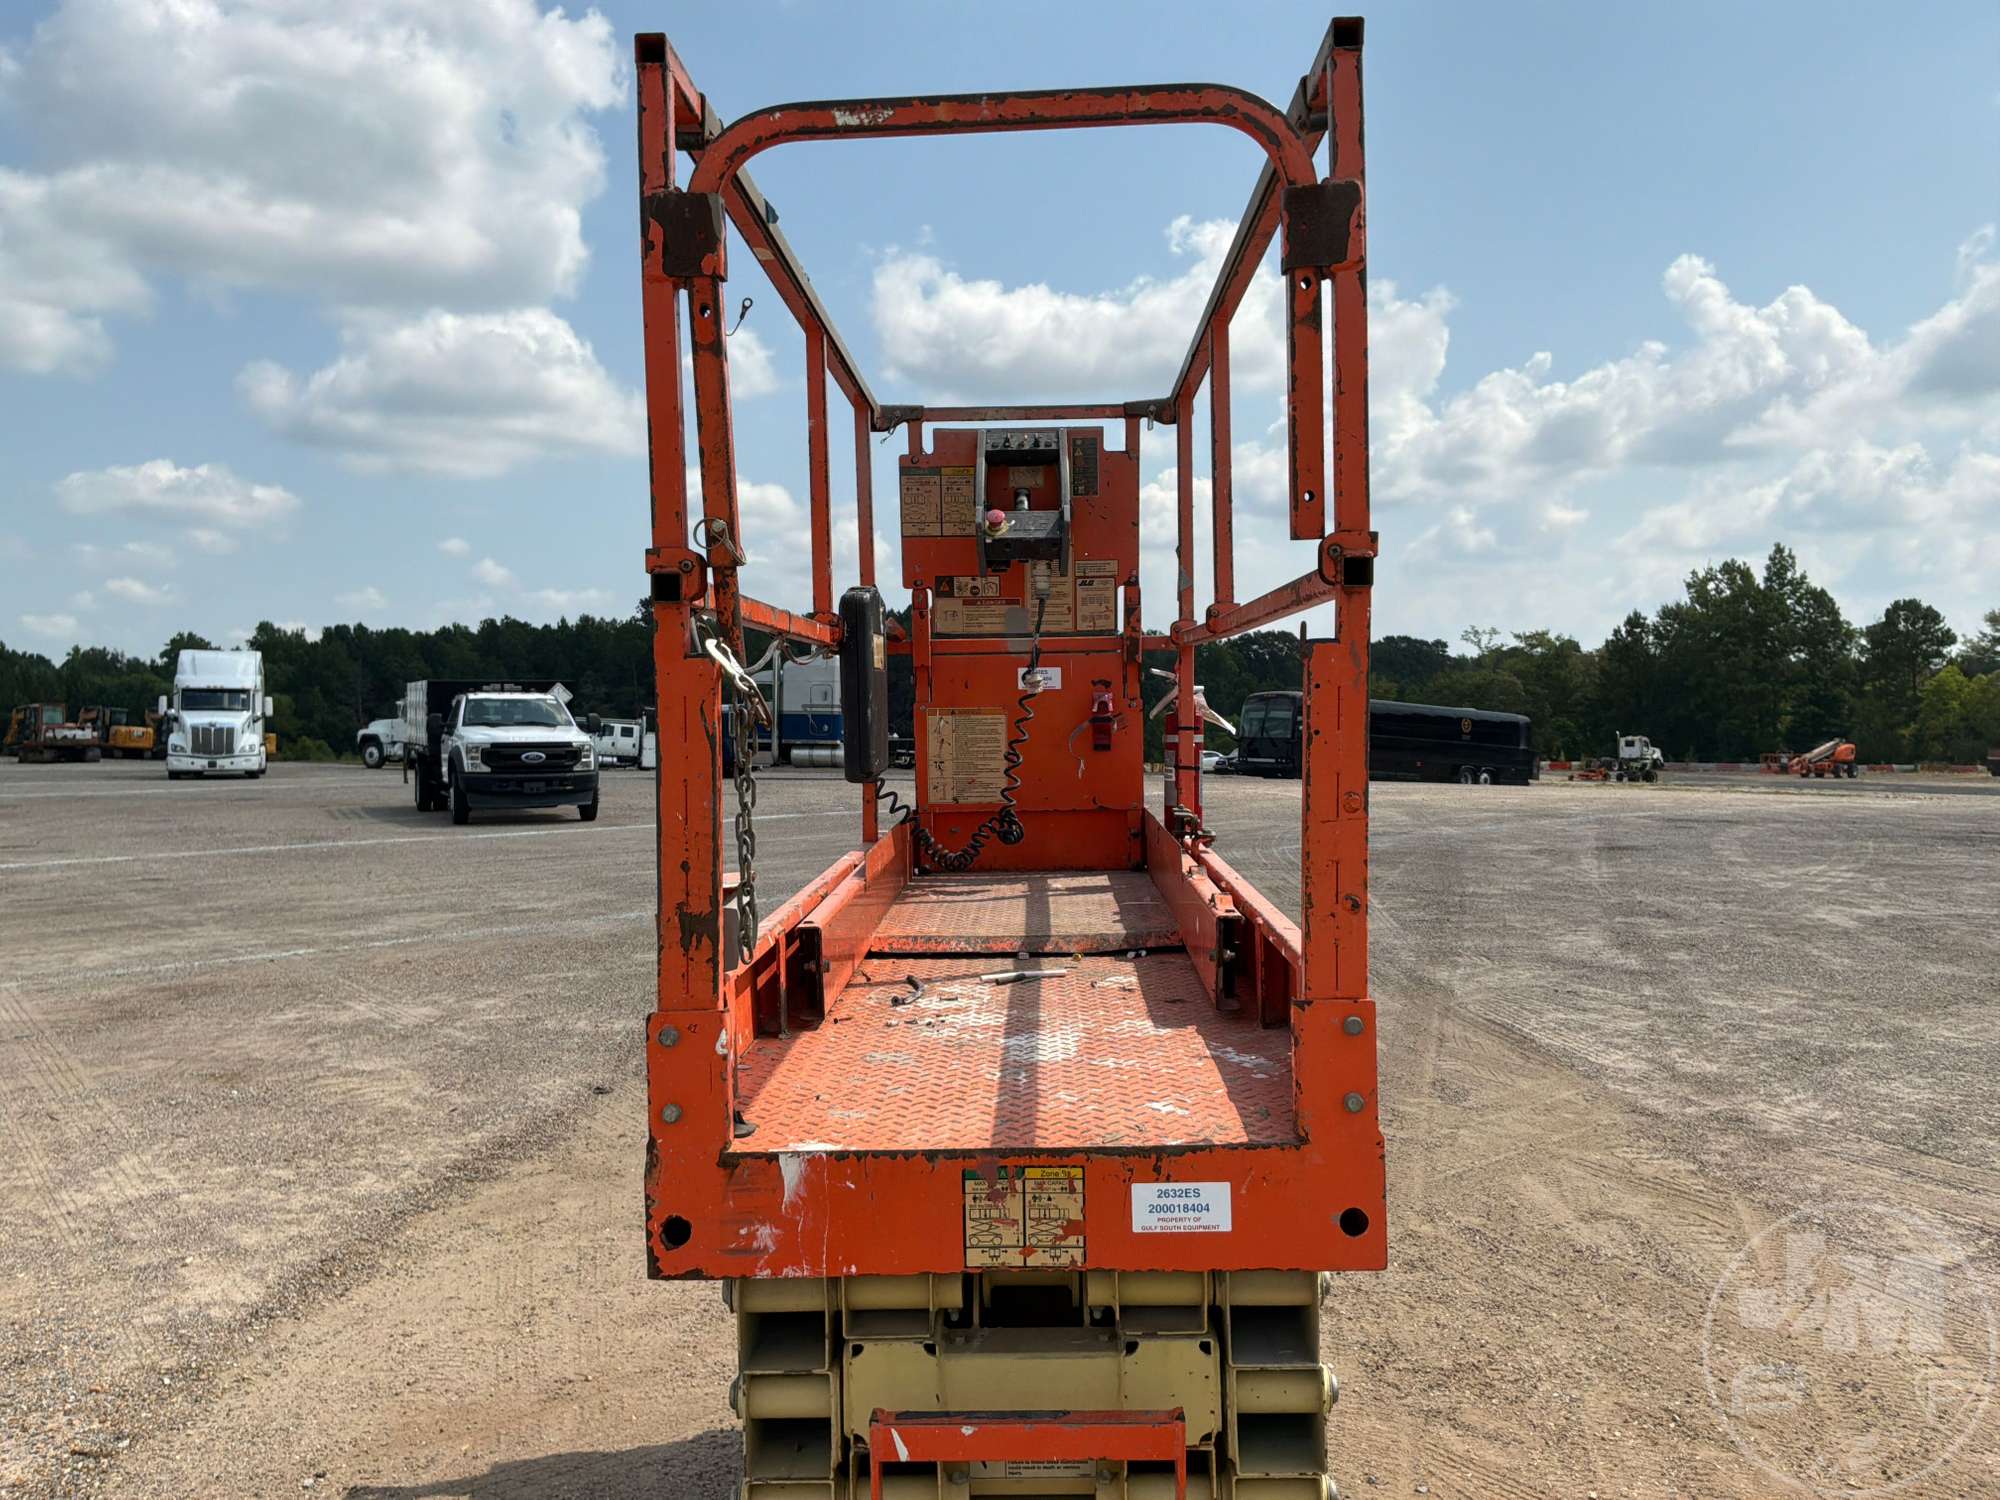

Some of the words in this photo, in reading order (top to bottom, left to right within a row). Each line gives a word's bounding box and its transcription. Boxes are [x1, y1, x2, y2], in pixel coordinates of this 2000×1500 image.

[1040, 1169, 1060, 1178] Zone
[1156, 1187, 1201, 1199] 2632ES
[1148, 1203, 1211, 1214] 200018404
